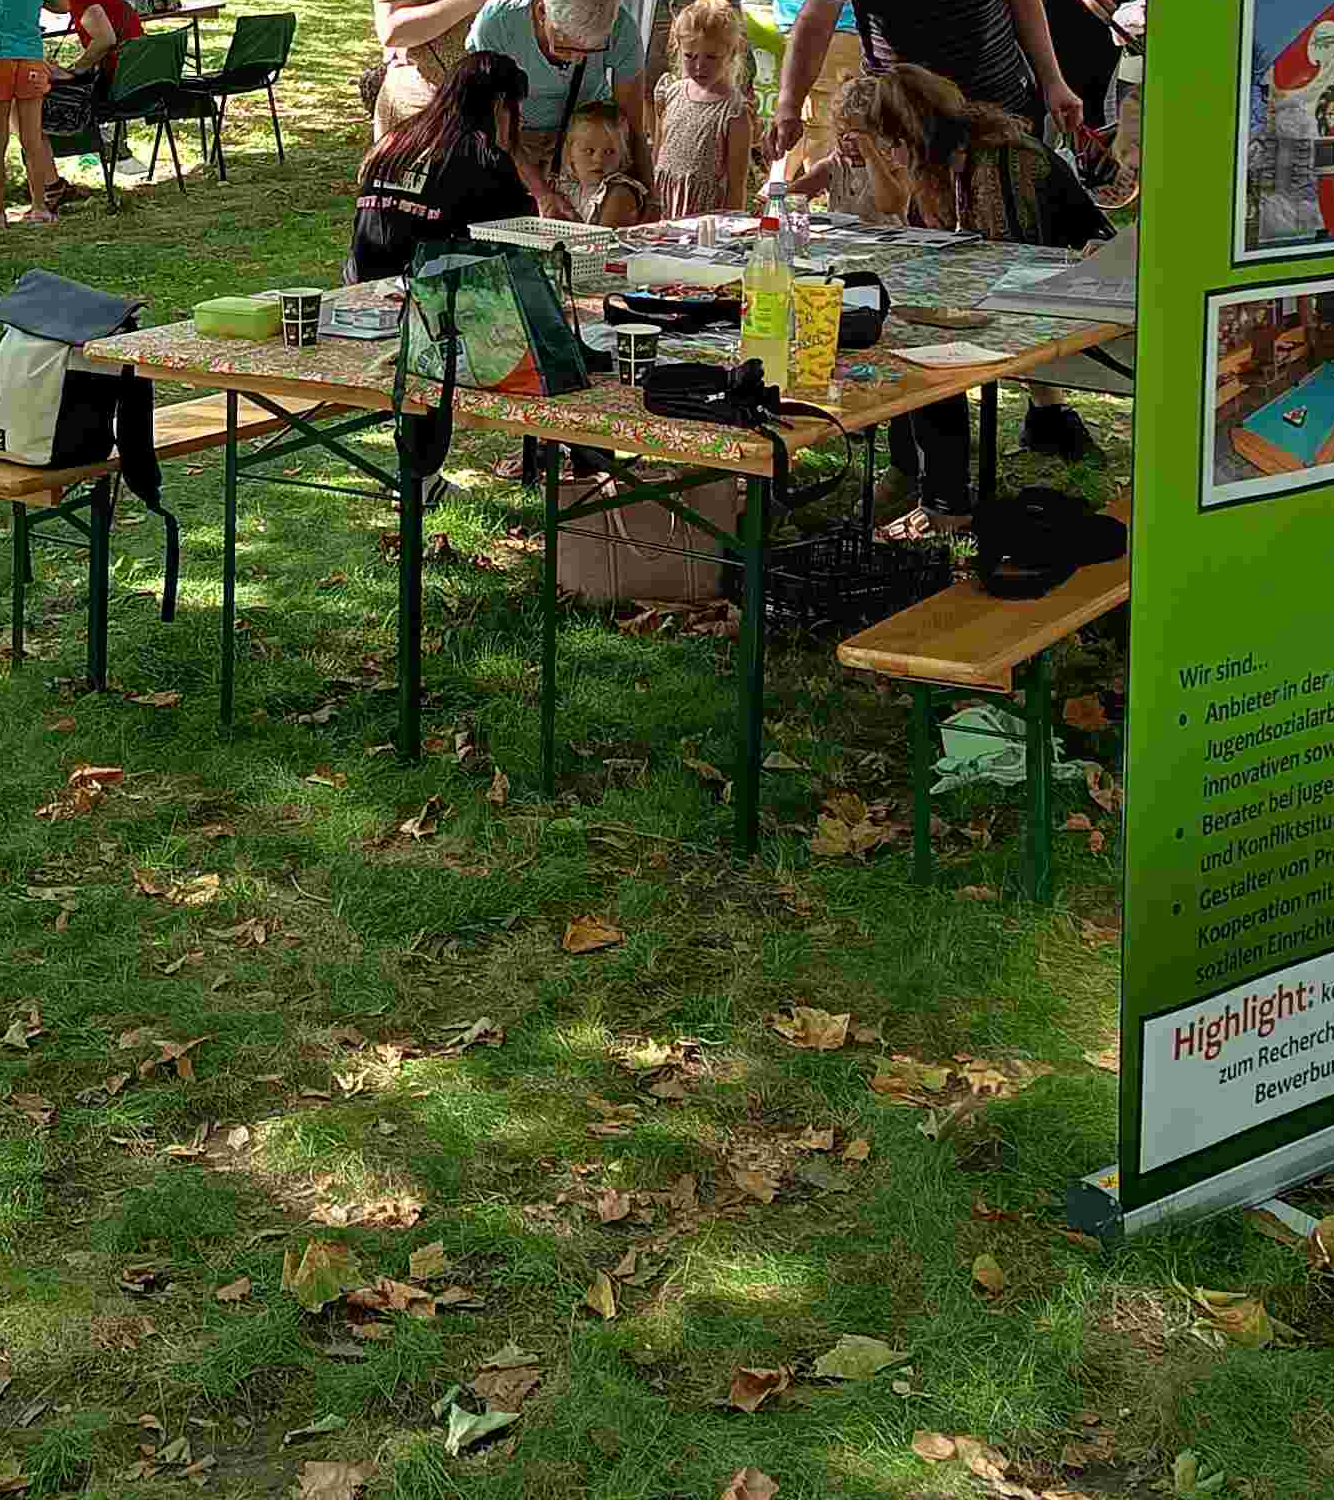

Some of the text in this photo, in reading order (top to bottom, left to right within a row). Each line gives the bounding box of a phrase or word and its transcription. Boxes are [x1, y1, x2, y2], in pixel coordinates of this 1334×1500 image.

[1179, 651, 1268, 688] Wir sind...
[1205, 693, 1279, 724] Anbieter
[1283, 680, 1298, 700] in
[1301, 671, 1330, 695] der
[1202, 749, 1301, 797] innovativen
[1202, 801, 1265, 836] Berater
[1269, 789, 1294, 812] bei
[1200, 841, 1233, 873] und
[1200, 867, 1275, 910] Gestalter
[1279, 858, 1310, 880] von
[1197, 896, 1301, 948] Kooperation
[1305, 880, 1334, 905] mit
[1194, 943, 1263, 985] sozialen
[1173, 980, 1315, 1061] Highlight:
[1218, 1056, 1254, 1085] zum
